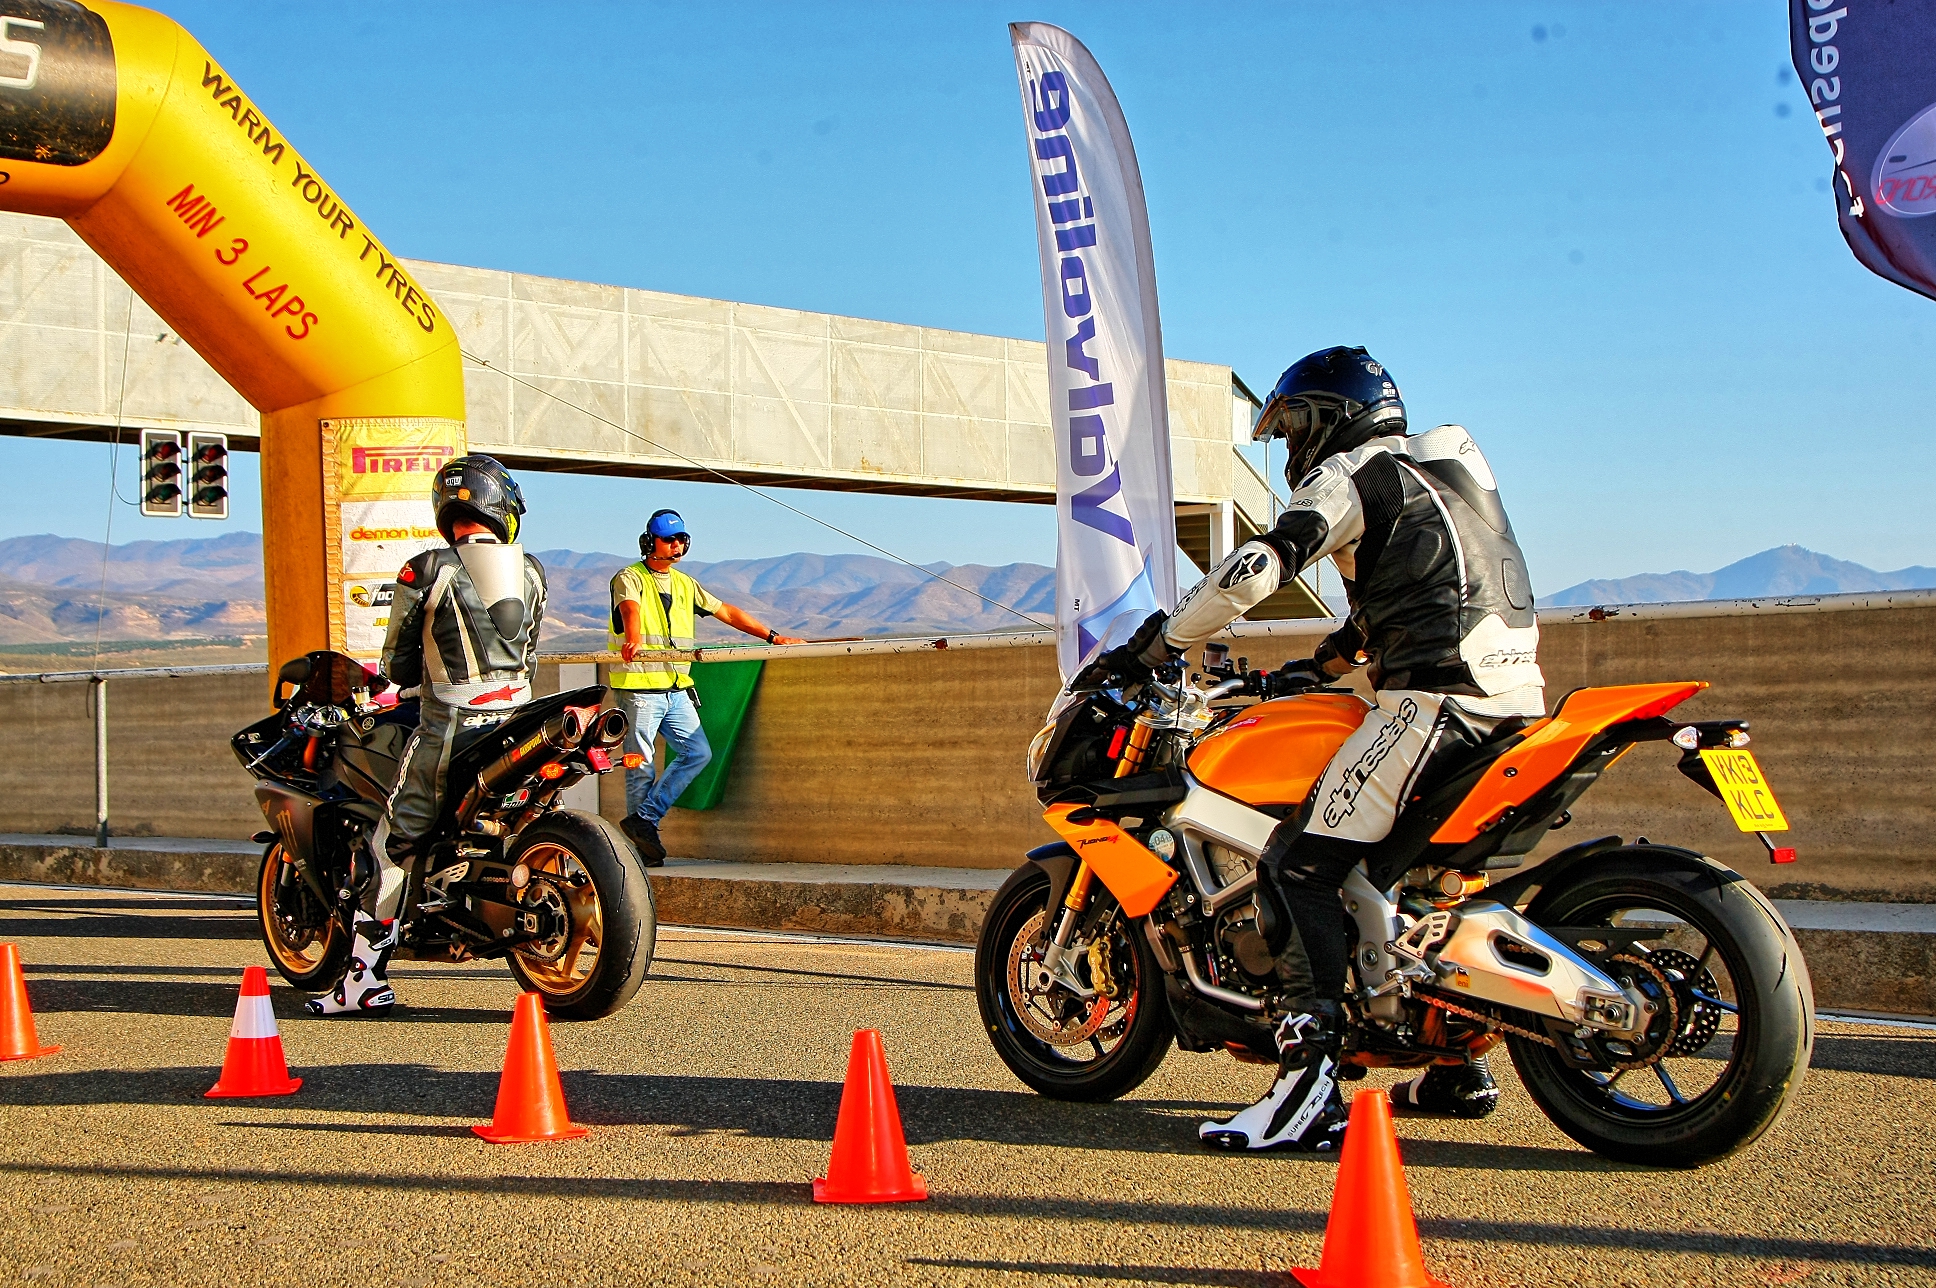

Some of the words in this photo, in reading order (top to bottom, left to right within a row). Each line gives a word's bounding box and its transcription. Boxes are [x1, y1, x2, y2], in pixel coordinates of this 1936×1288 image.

[201, 60, 284, 165] WARM
[292, 161, 354, 239] YOUR
[359, 233, 436, 333] TYRES
[166, 184, 226, 238] MIN
[215, 238, 248, 266] 3
[242, 266, 318, 340] LAPS
[350, 525, 409, 541] demon
[1730, 790, 1774, 820] KLC
